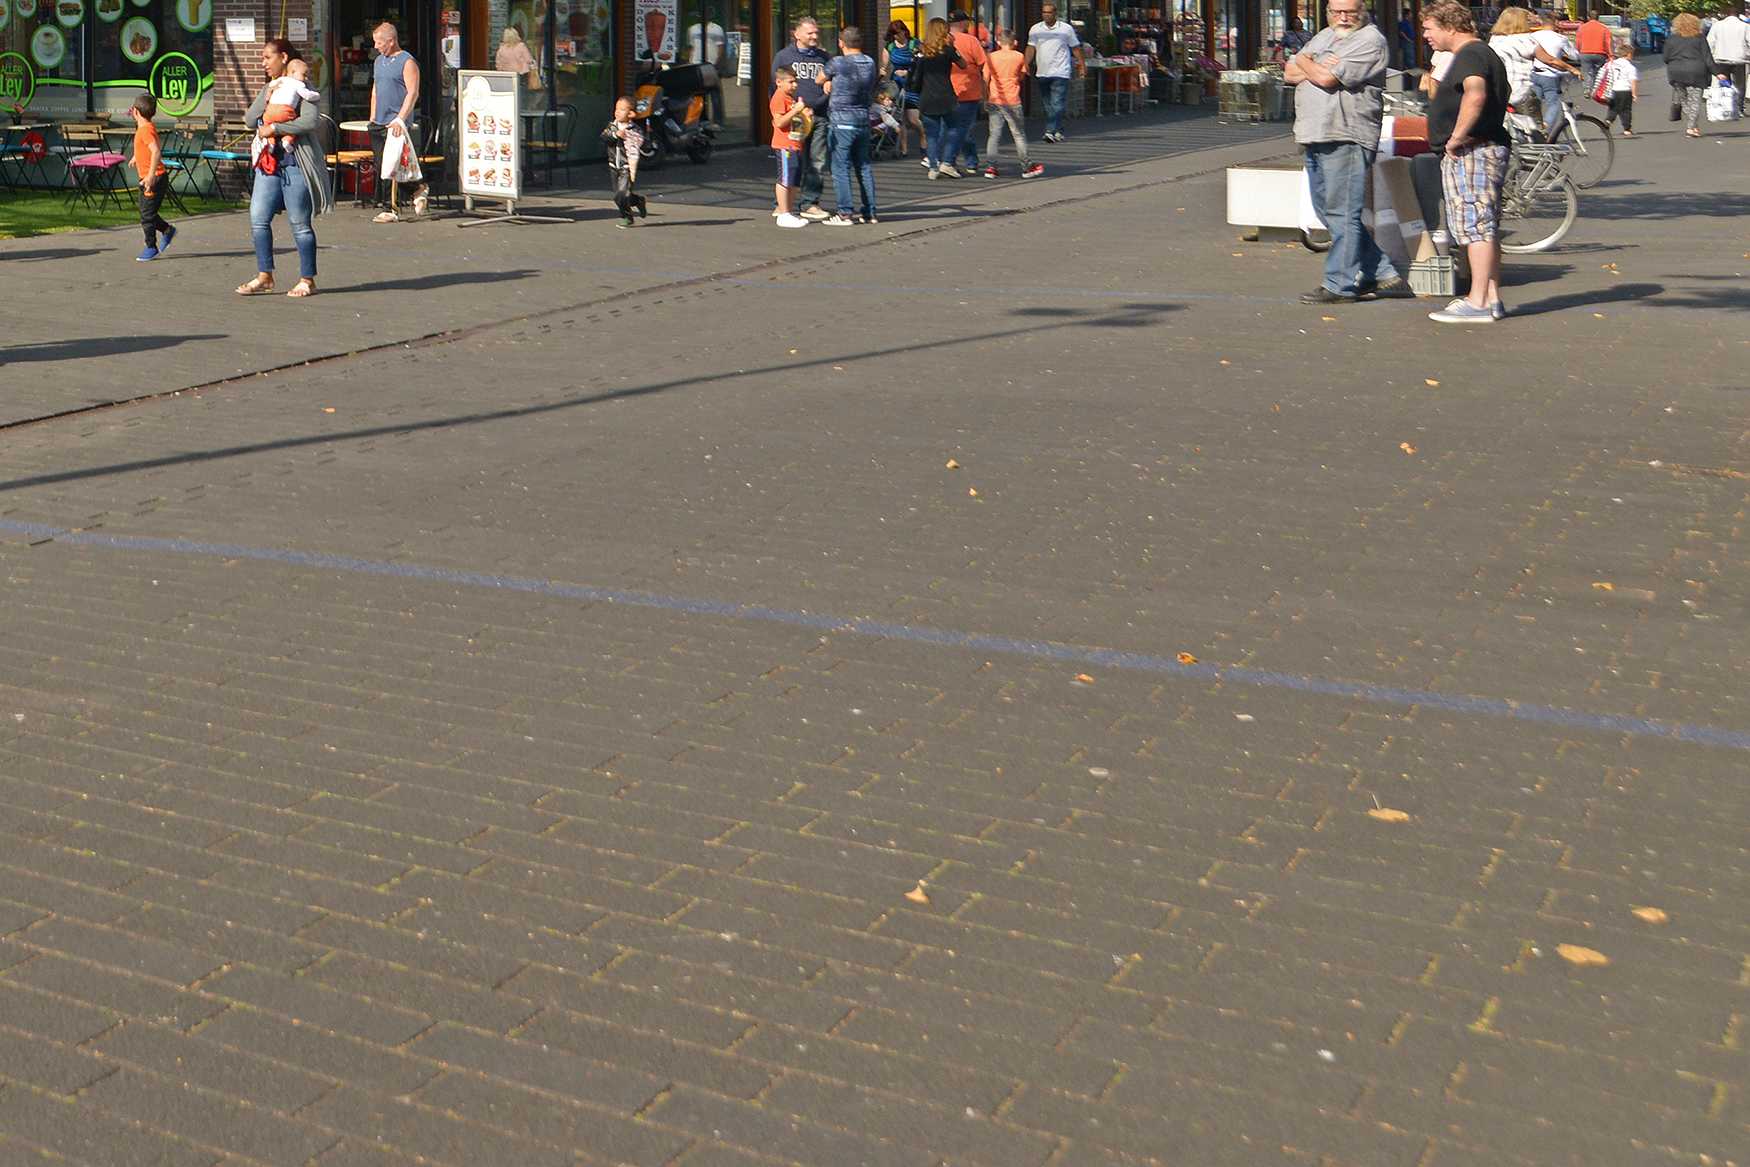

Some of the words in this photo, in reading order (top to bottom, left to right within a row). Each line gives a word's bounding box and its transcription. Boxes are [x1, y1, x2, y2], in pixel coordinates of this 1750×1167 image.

[667, 9, 675, 50] KEBAB
[1, 65, 23, 76] ALLER
[162, 65, 188, 76] ALLER
[0, 74, 23, 101] Ley
[162, 75, 188, 104] Ley
